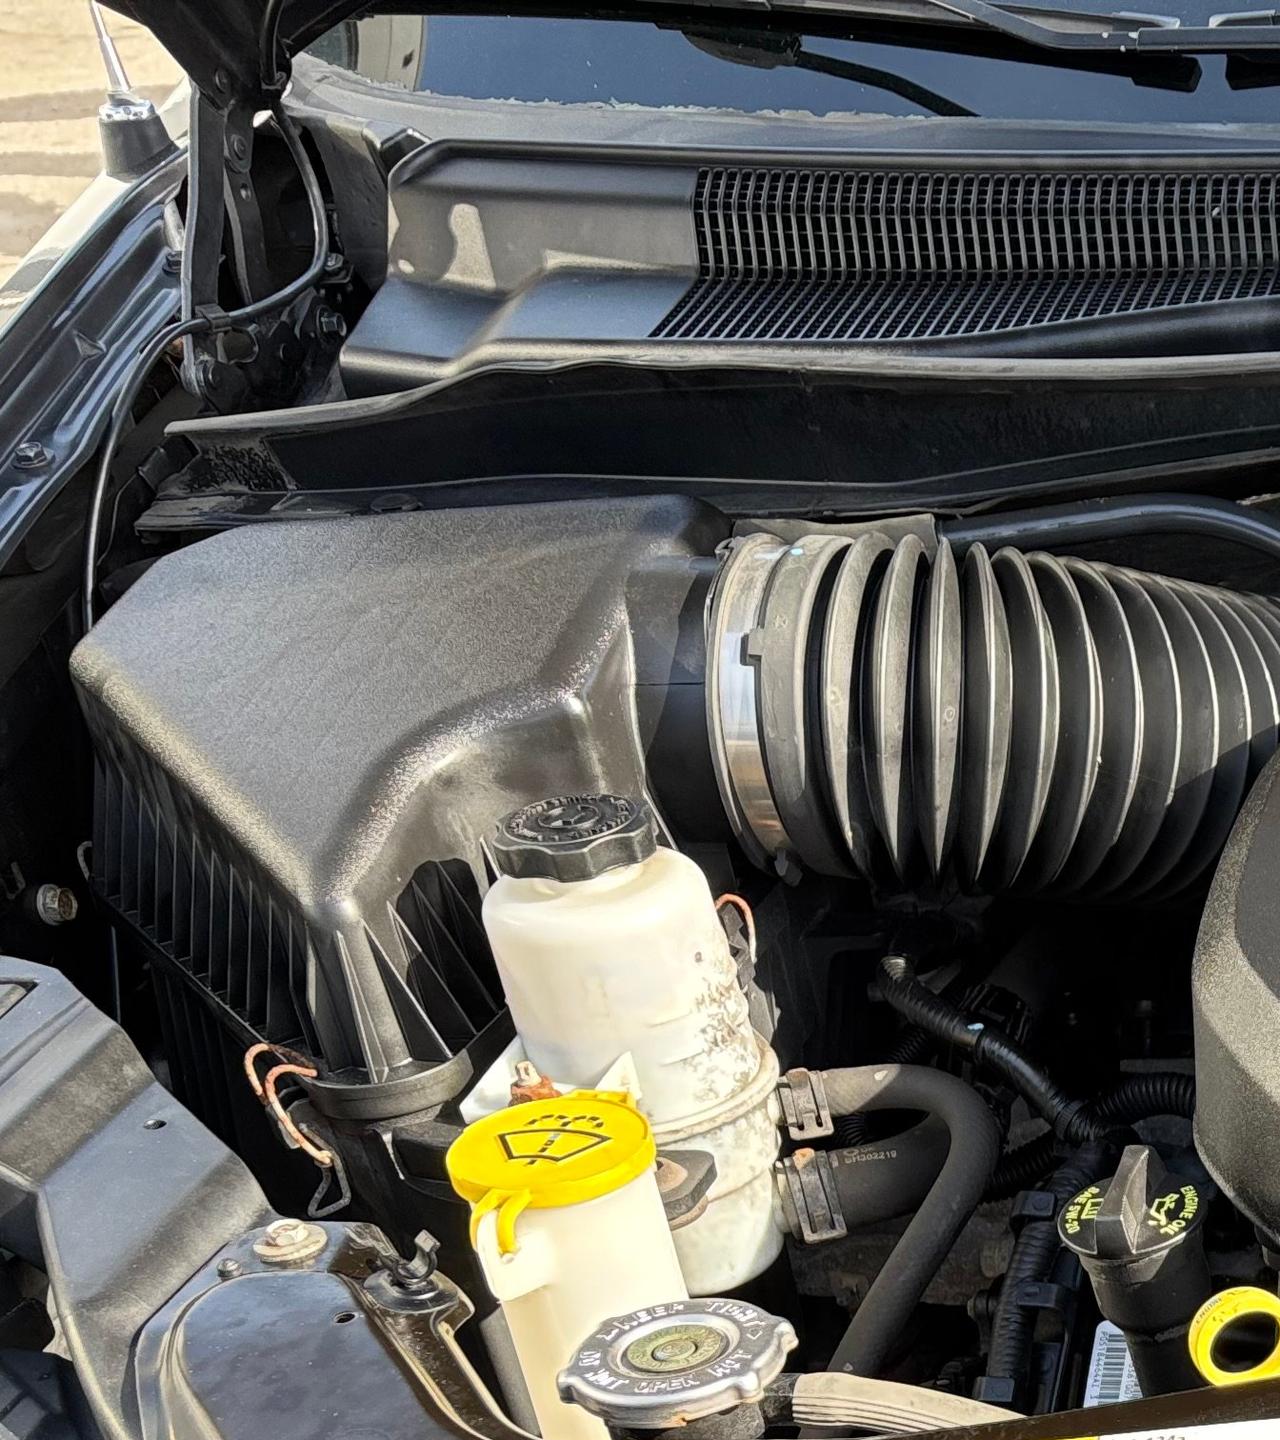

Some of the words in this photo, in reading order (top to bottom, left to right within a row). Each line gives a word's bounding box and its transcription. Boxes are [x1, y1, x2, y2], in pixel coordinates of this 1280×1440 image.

[1073, 1186, 1100, 1204] SAE
[1180, 1185, 1199, 1219] ENGINE
[1160, 1219, 1186, 1236] OIL
